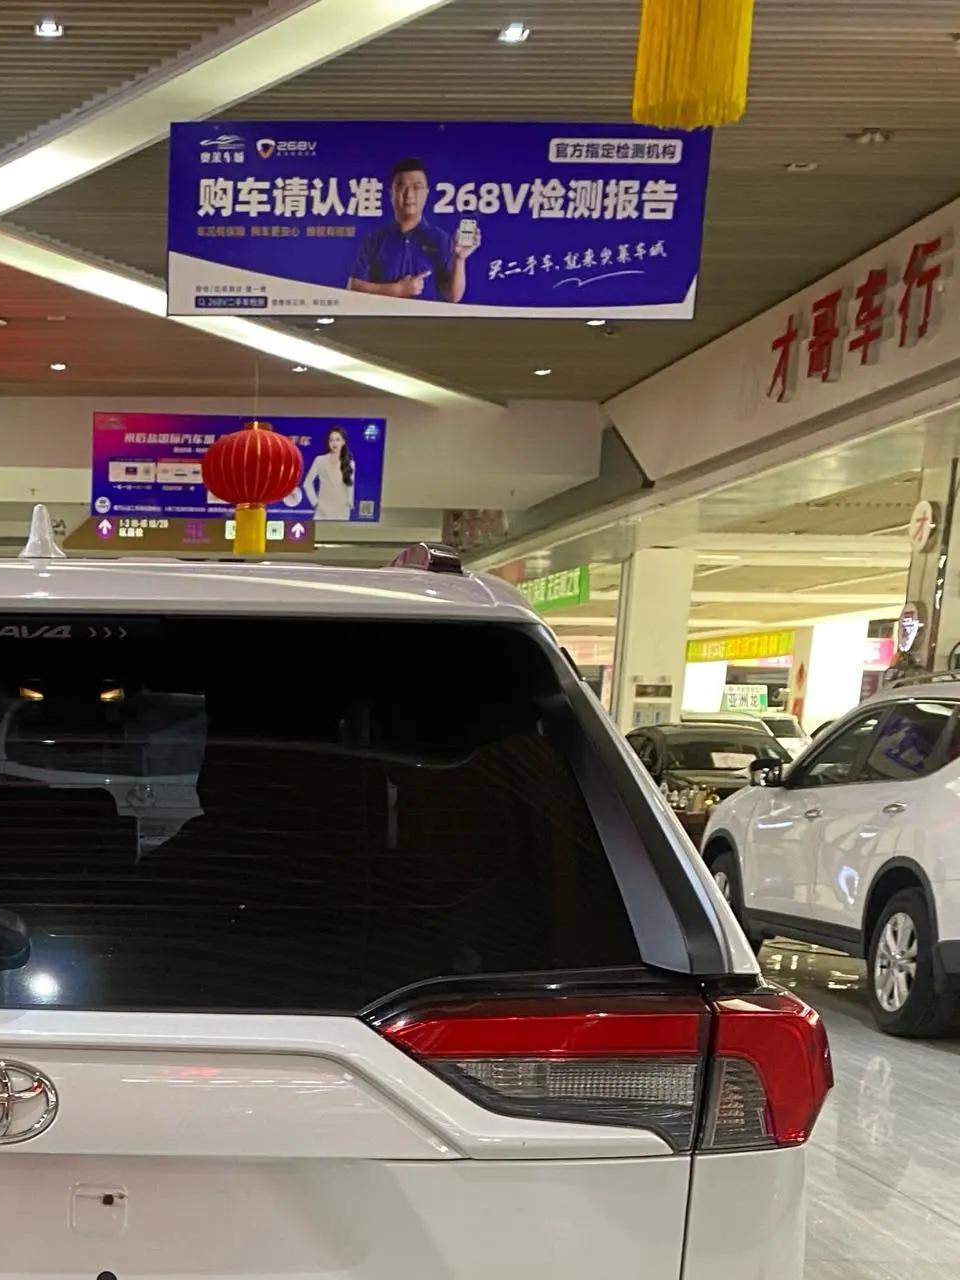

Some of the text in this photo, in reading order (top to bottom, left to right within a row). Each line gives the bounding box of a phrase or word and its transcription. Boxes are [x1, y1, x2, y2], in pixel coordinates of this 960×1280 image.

[276, 141, 317, 151] 268V
[554, 142, 677, 160] 官方指定检测机构
[197, 177, 679, 220] 购车请认准 268V检测报告
[766, 236, 942, 403] 才哥车行
